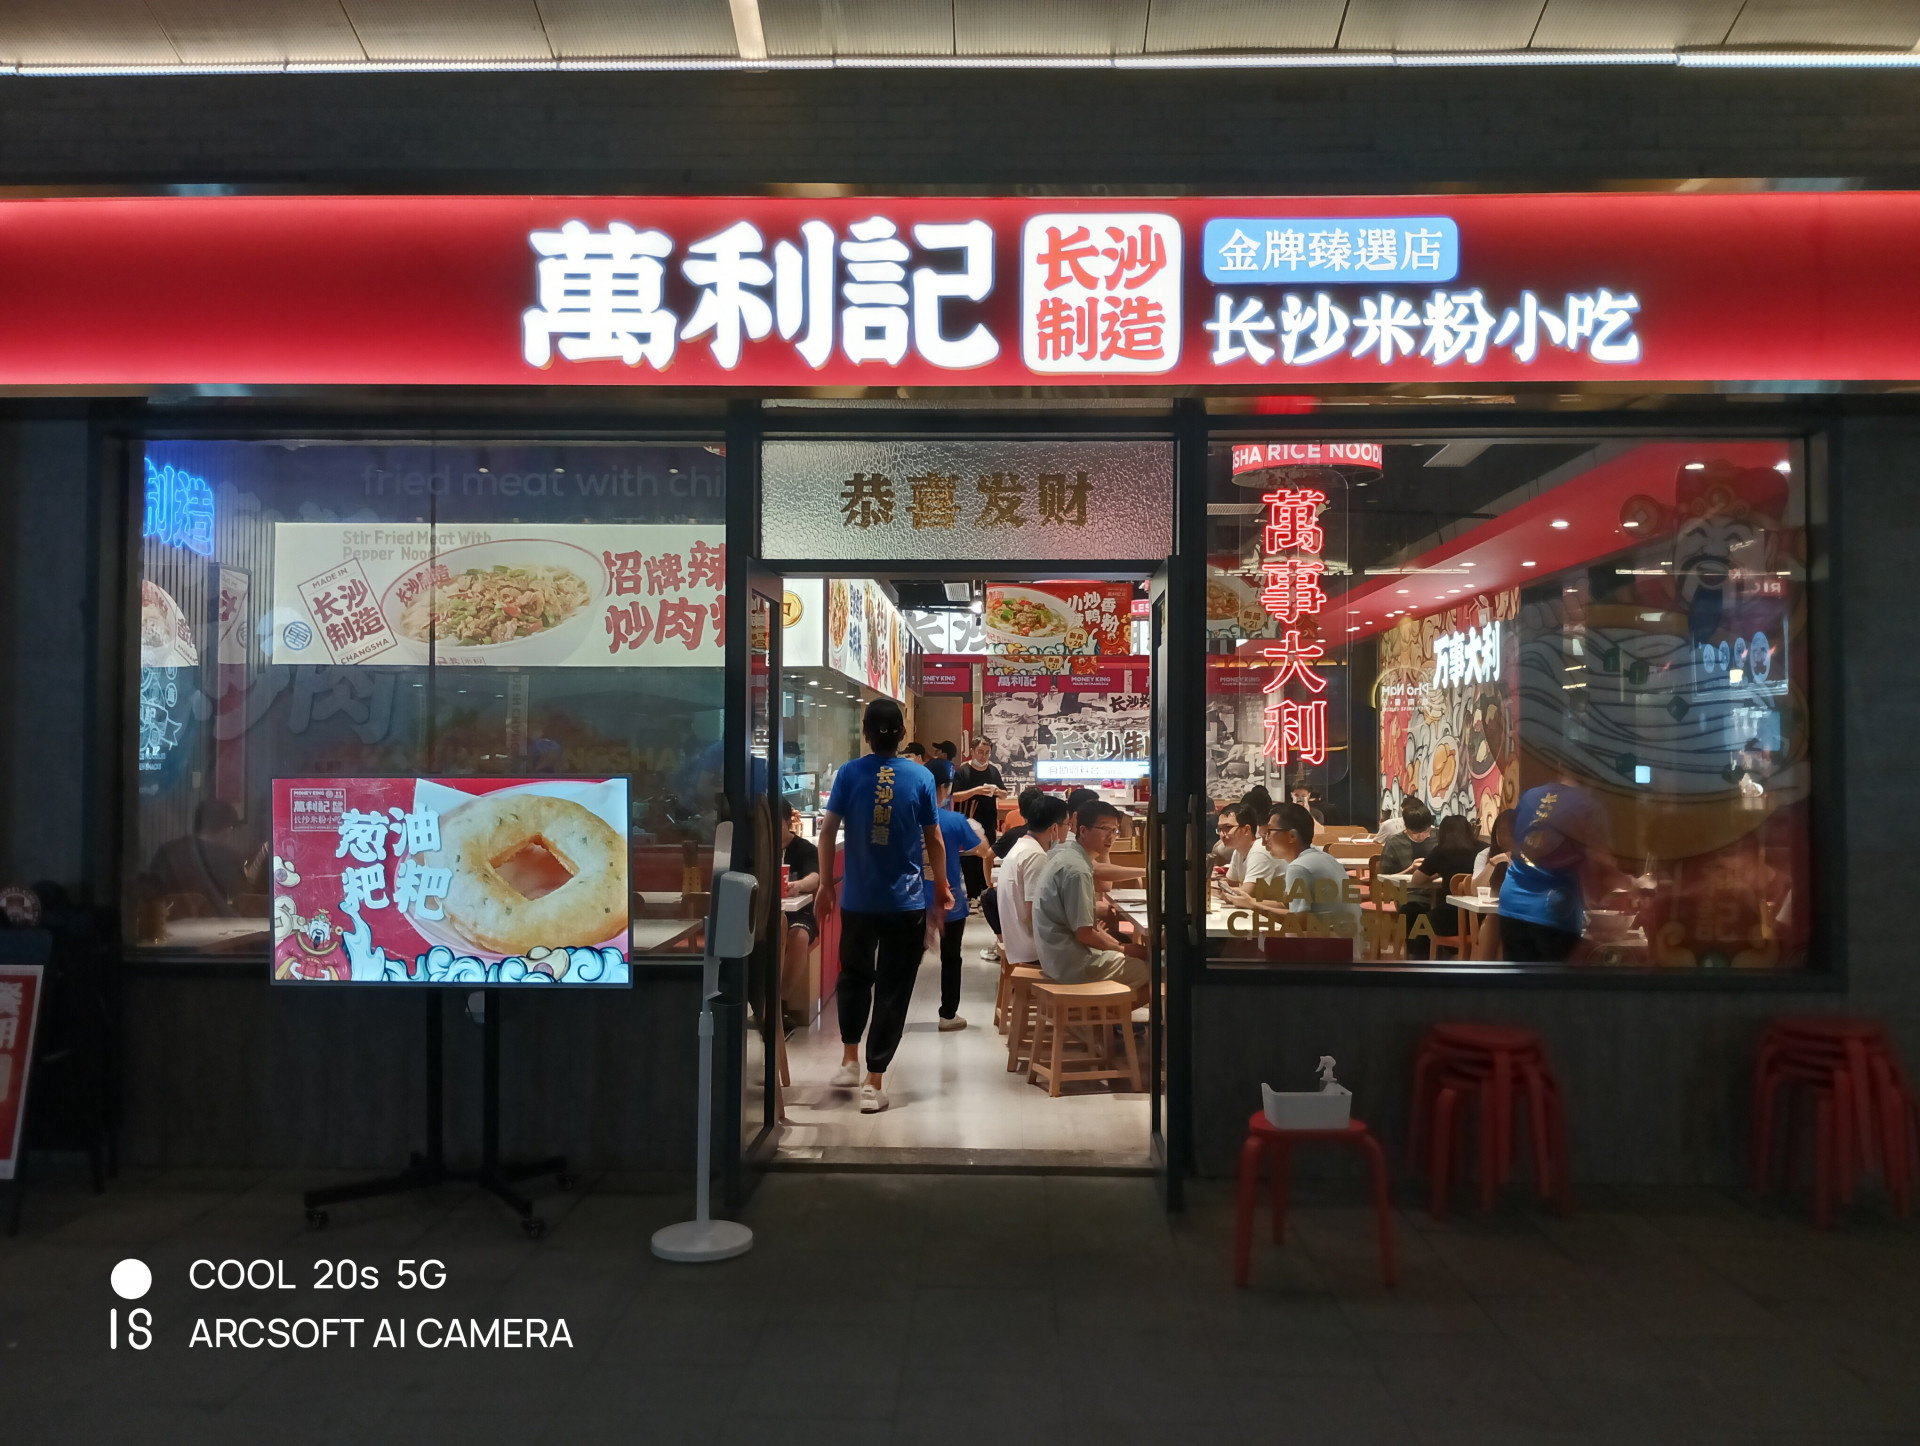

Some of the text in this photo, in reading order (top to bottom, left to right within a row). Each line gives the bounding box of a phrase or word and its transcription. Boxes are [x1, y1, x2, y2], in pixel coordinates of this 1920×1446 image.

[1037, 224, 1165, 290] 长沙
[1218, 227, 1446, 273] 金牌臻選店
[521, 217, 1000, 372] 萬利記
[1037, 297, 1165, 362] 制造
[1204, 289, 1642, 366] 长沙米粉小吃
[361, 464, 450, 497] fried
[463, 466, 564, 497] meat
[576, 464, 658, 497] with
[840, 472, 1094, 529] 恭喜发财
[342, 531, 371, 545] Stir
[375, 531, 413, 545] Fried
[458, 531, 492, 545] With
[343, 547, 394, 561] Pepper
[312, 567, 348, 590] MADE IN
[313, 579, 368, 624] 长沙
[325, 607, 385, 652] 制造
[340, 638, 390, 664] CHANGSHA
[1261, 489, 1327, 767] 萬事大利
[1433, 621, 1501, 690] 万事大利
[998, 676, 1037, 687] 萬利記
[868, 767, 895, 846] 长沙制造
[336, 803, 442, 862] 葱油
[341, 859, 453, 922] 粑粑
[1255, 878, 1408, 905] MADE IN
[1227, 911, 1435, 939] CHANGSHA
